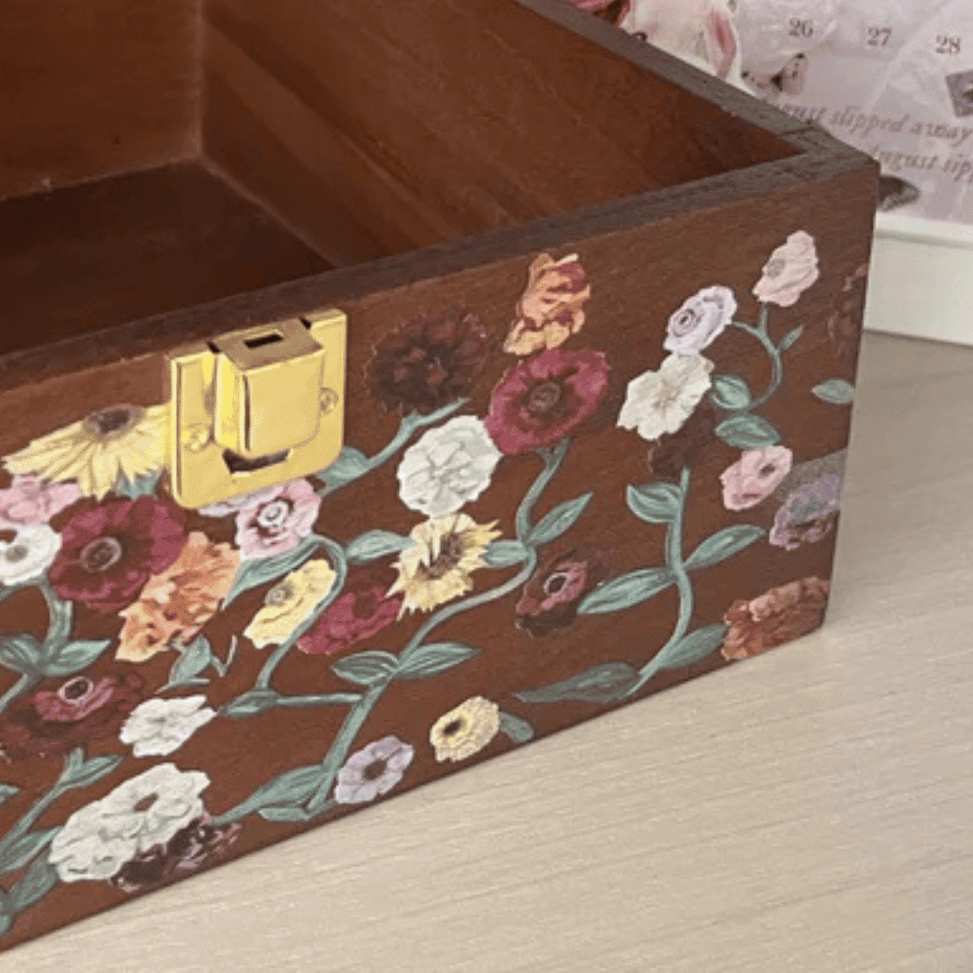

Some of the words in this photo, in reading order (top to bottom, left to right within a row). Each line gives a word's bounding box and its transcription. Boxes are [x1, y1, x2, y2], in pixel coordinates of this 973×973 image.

[788, 17, 814, 38] 26
[867, 27, 892, 47] 27
[935, 34, 962, 55] 28
[829, 106, 910, 139] slipped
[909, 121, 973, 148] away
[869, 144, 938, 172] ugust
